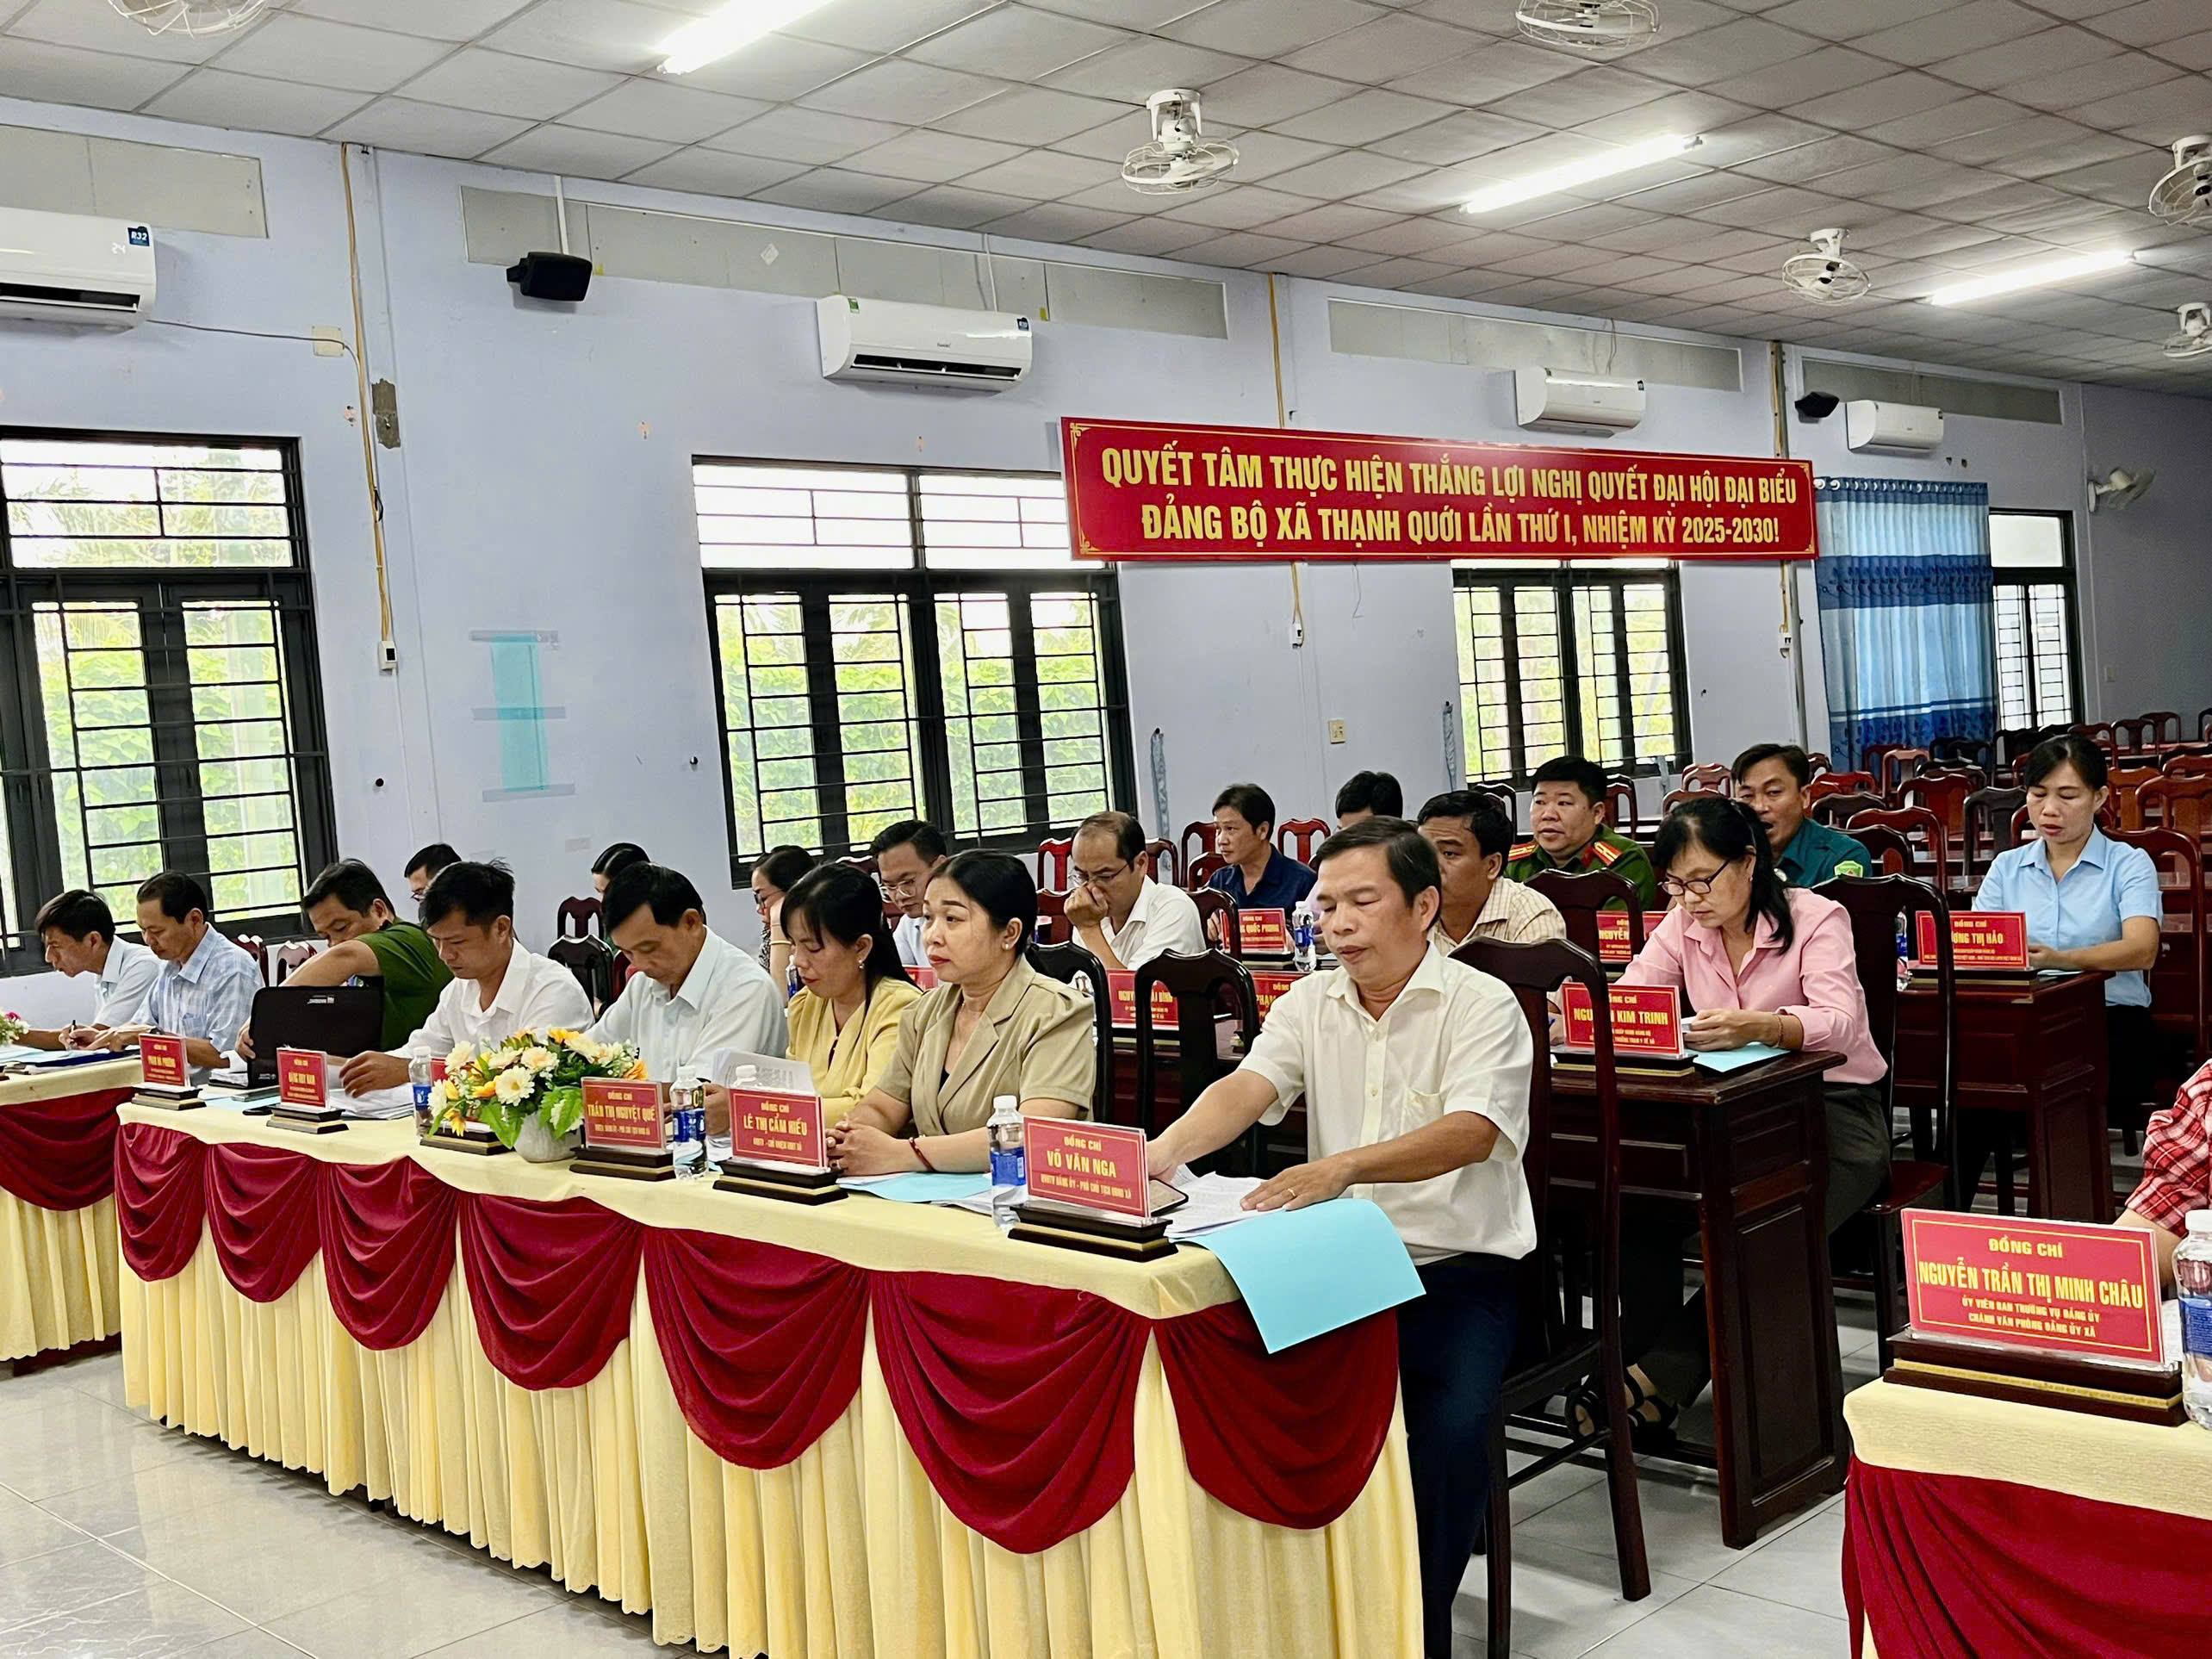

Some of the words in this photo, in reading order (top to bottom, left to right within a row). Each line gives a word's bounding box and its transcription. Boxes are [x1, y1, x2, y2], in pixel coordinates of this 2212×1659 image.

[1102, 440, 1193, 488] QUYẾT
[1202, 446, 1263, 488] TÂM
[1270, 455, 1338, 497] THỰC
[1345, 455, 1403, 499] HIỆN
[1409, 453, 1485, 496] THẮNG
[1492, 463, 1525, 503] LỢI
[1532, 469, 1582, 505] NGHỊ
[1588, 464, 1648, 500] QUYẾT
[1654, 474, 1684, 506] ĐẠI
[1690, 469, 1719, 507] HỘI
[1724, 475, 1754, 508] ĐẠI
[1759, 468, 1797, 504] BIỂU
[1141, 494, 1222, 540] ĐẢNG
[1231, 500, 1267, 547] BỘ
[1276, 501, 1311, 541] XÃ
[1317, 508, 1400, 548] THẠNH
[1407, 504, 1462, 544] QUỚI
[1469, 502, 1512, 543] LẦN
[1517, 507, 1559, 543] THỨ
[1564, 514, 1577, 546] I,
[1583, 510, 1647, 549] NHIỆM
[1653, 510, 1676, 544] KỲ
[1682, 517, 1780, 543] 2025-2030!
[1617, 1010, 1636, 1023] KIM
[1638, 1011, 1668, 1025] TRINH
[1047, 1148, 1062, 1167] VÕ
[1066, 1153, 1090, 1172] VĂN
[1092, 1159, 1116, 1178] NGA
[1988, 1235, 2033, 1254] ĐỒNG
[2037, 1242, 2063, 1258] CHÍ
[1918, 1257, 1979, 1289] NGUYỄN
[1982, 1262, 2022, 1295] TRẦN
[2026, 1273, 2052, 1303] THỊ
[2054, 1276, 2095, 1303] MINH
[2099, 1278, 2143, 1309] CHÂU
